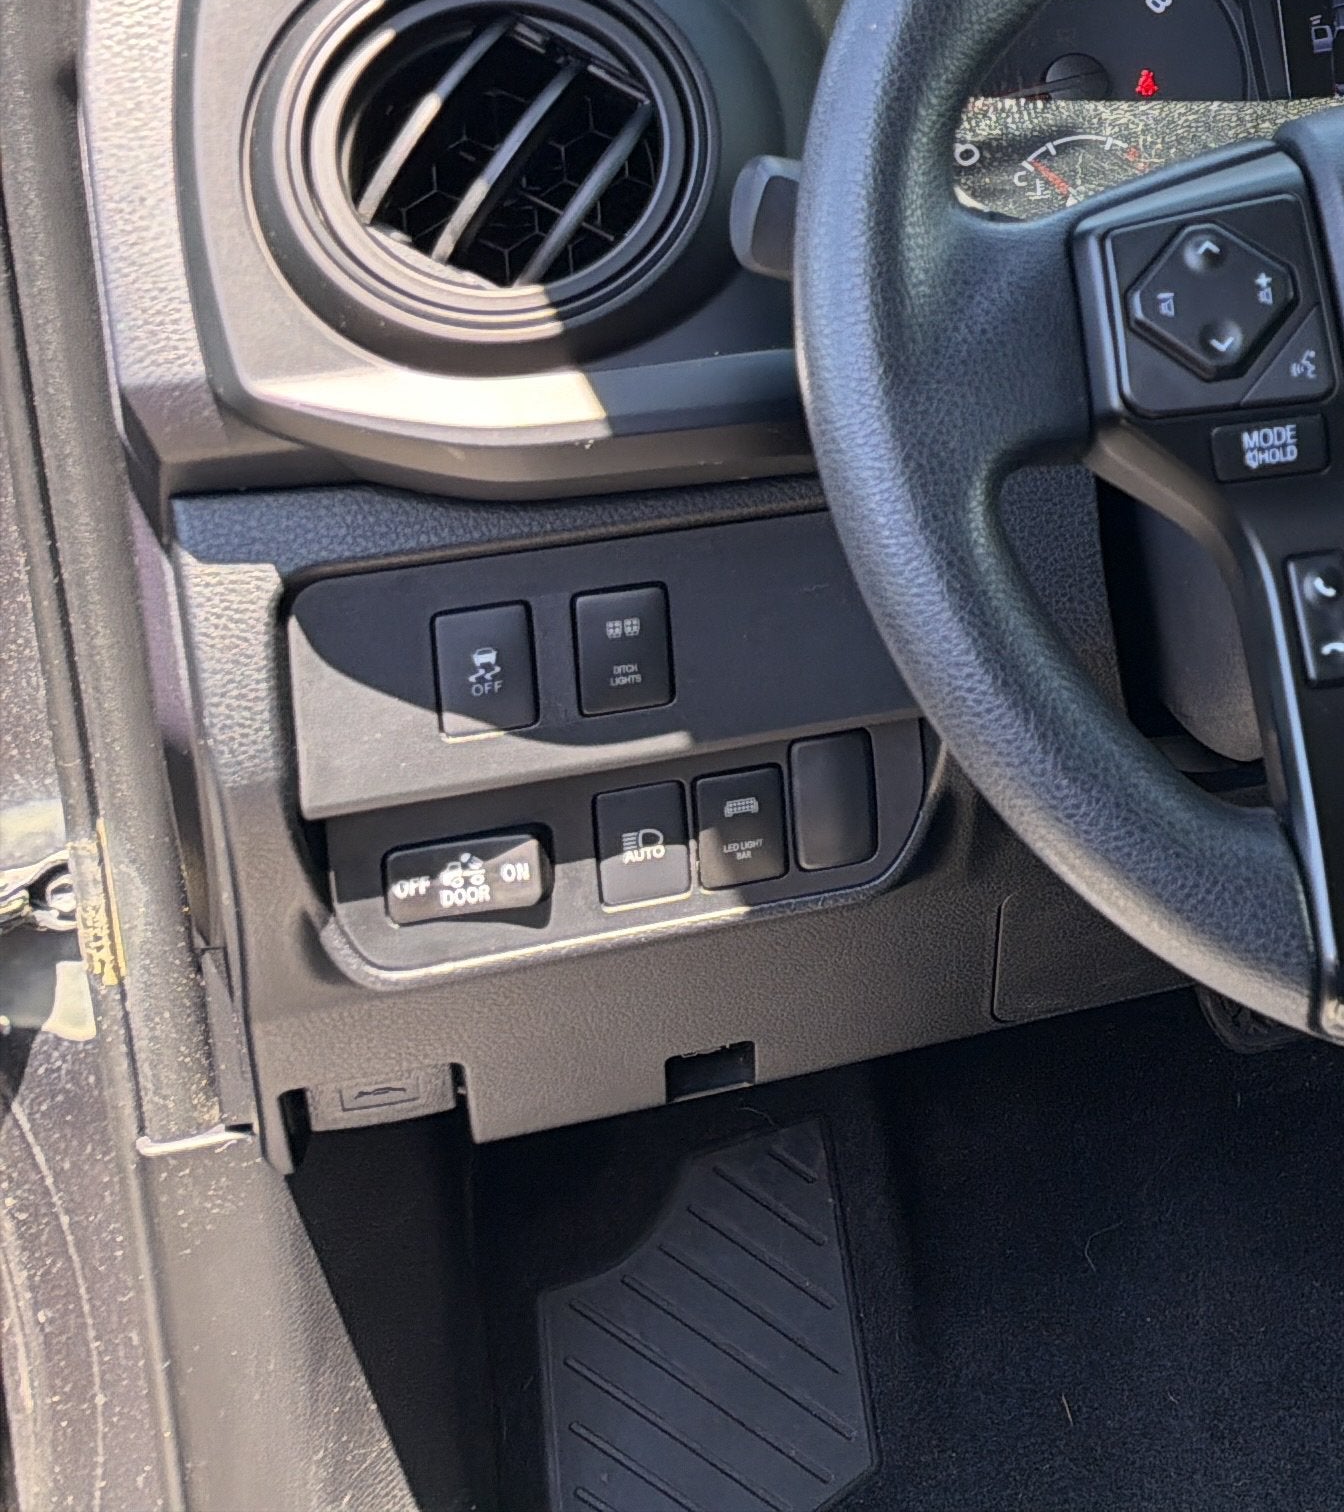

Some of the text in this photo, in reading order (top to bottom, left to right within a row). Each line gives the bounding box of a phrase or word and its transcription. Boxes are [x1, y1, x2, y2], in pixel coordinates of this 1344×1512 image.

[1242, 424, 1297, 449] MODE
[1259, 445, 1298, 465] HOLD
[613, 663, 638, 675] DITCH
[471, 680, 502, 696] OFF
[610, 674, 642, 687] LIGHTS
[623, 845, 665, 864] AUTO
[723, 838, 763, 853] LED LIGHT
[737, 851, 752, 861] BAR
[501, 862, 530, 882] ON
[391, 876, 430, 899] OFF
[439, 885, 490, 908] DOOR
